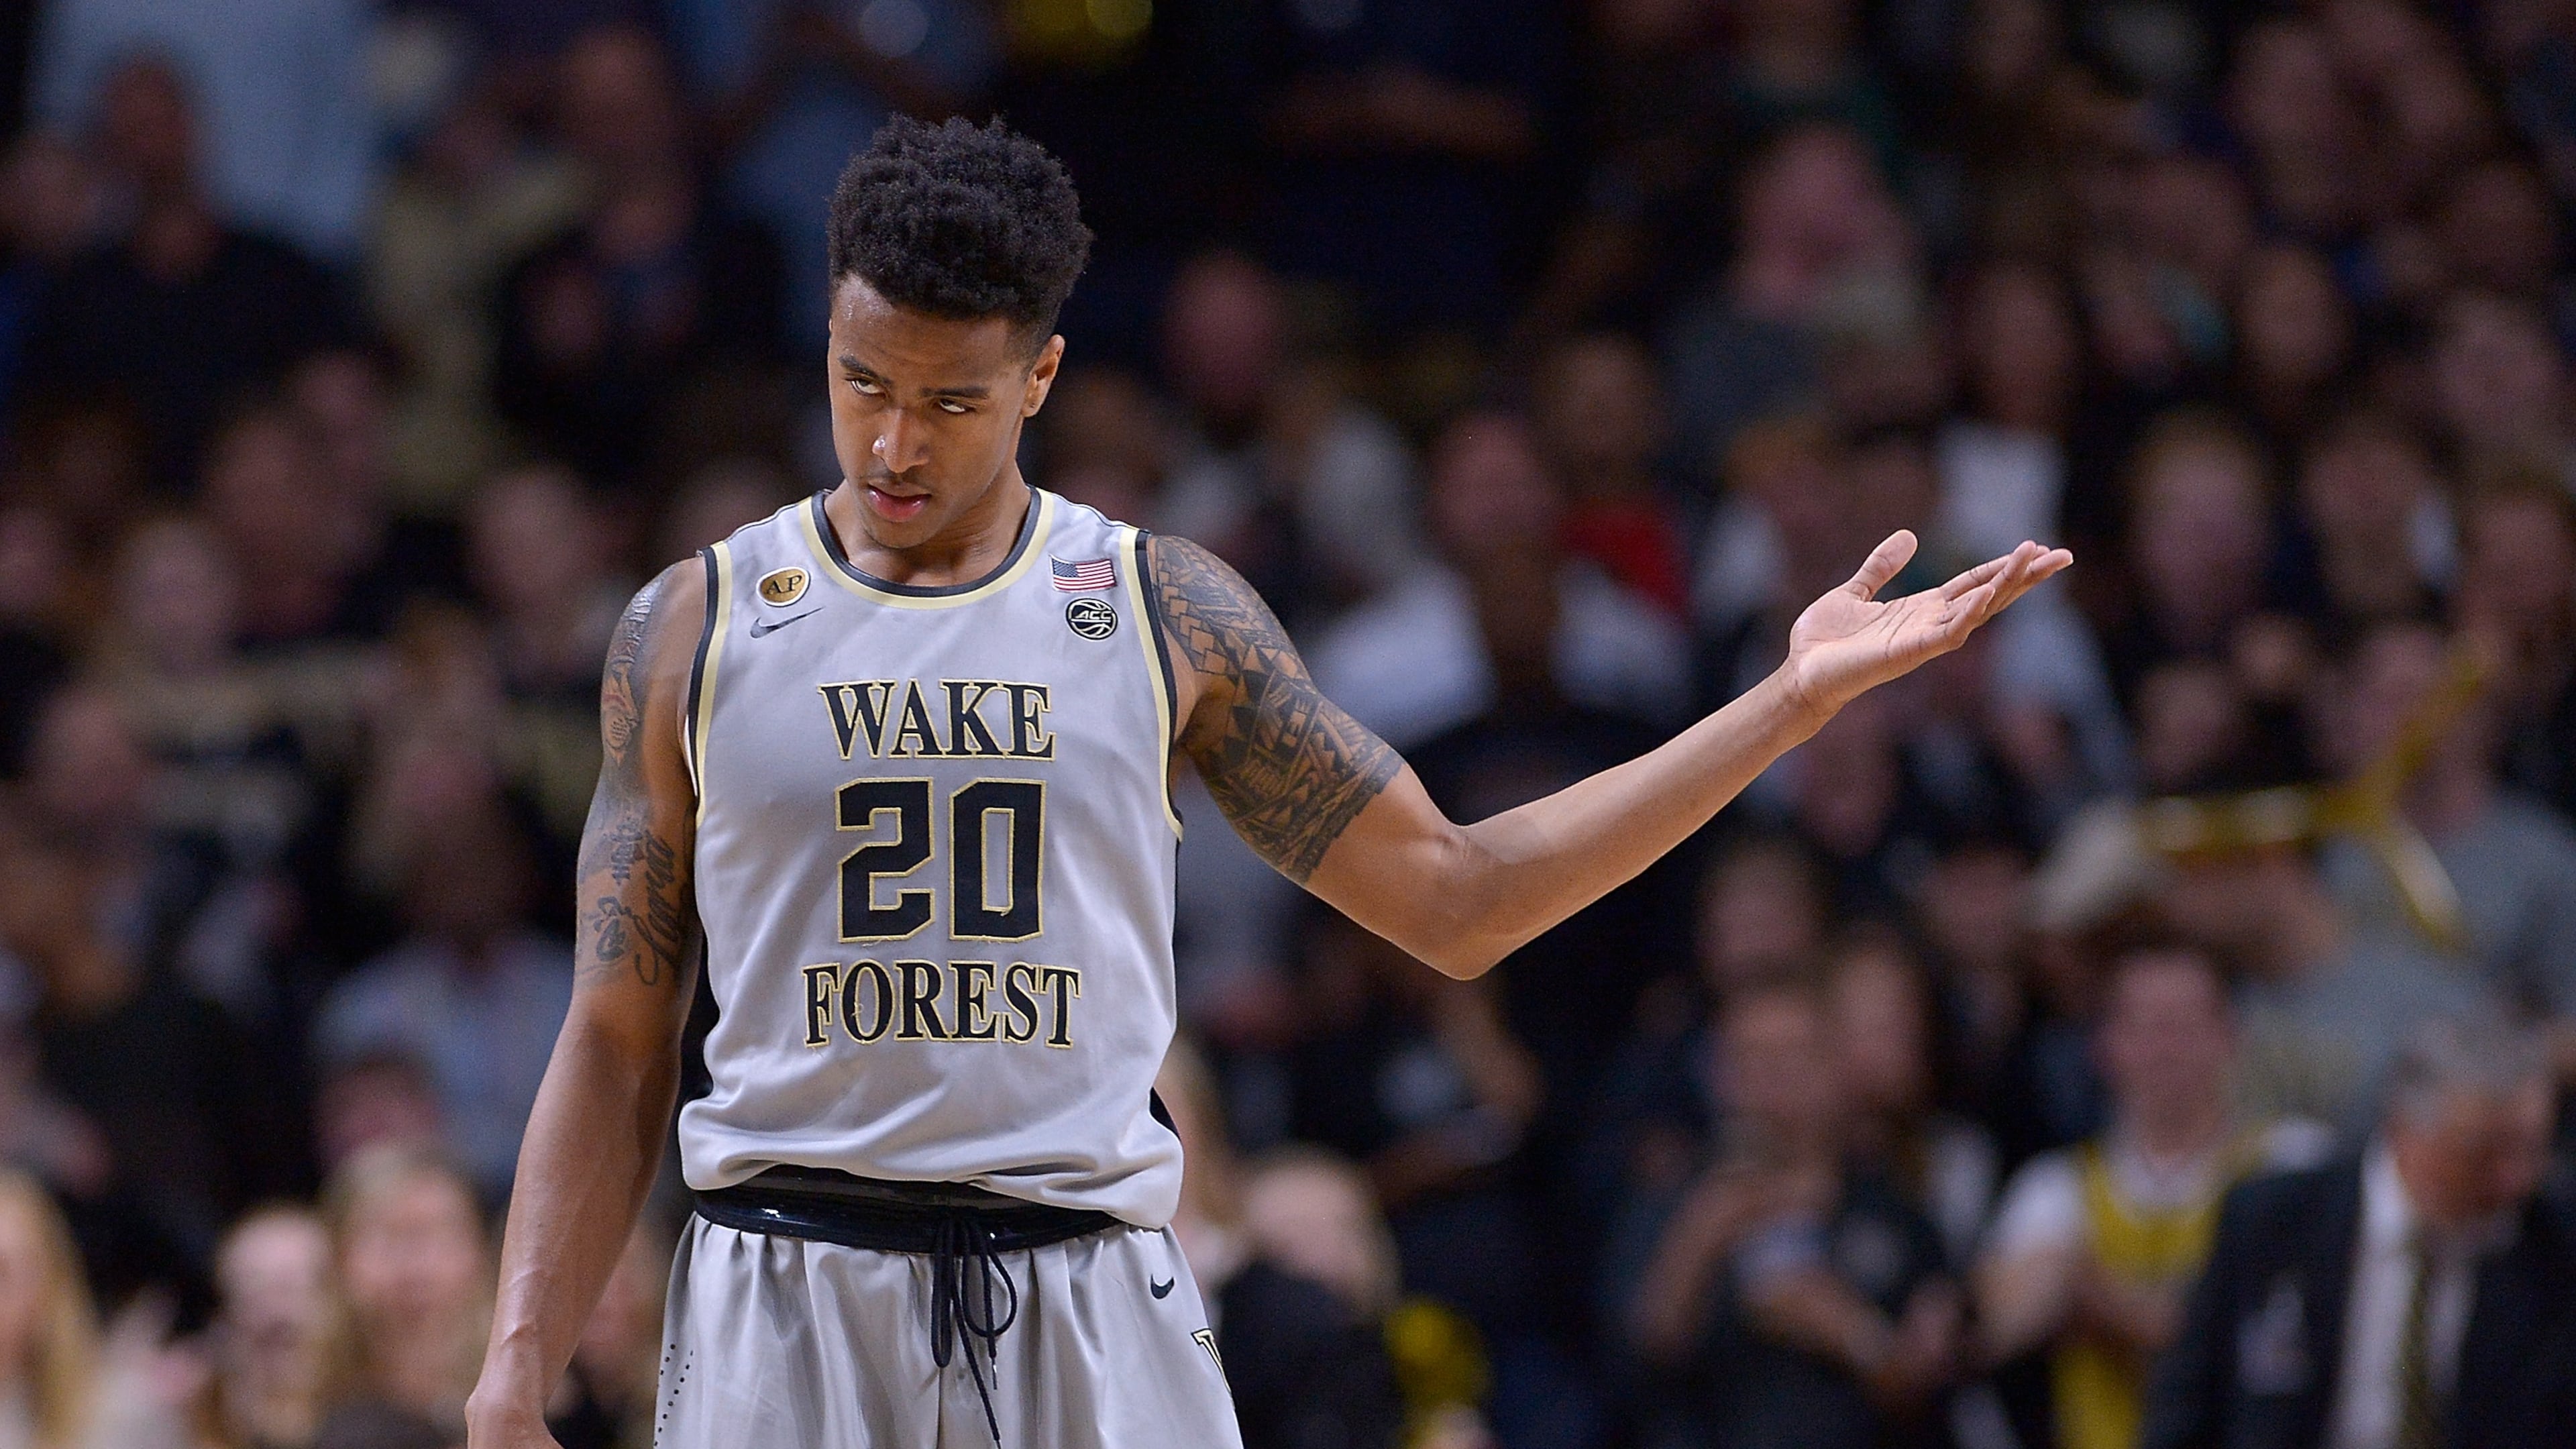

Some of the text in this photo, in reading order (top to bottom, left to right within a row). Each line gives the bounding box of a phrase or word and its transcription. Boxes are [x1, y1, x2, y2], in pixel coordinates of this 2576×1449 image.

[765, 575, 802, 595] AP
[1074, 610, 1112, 619] ACC
[817, 678, 1057, 761] WAKE
[835, 777, 1046, 943] 20
[802, 959, 1081, 1049] FOREST
